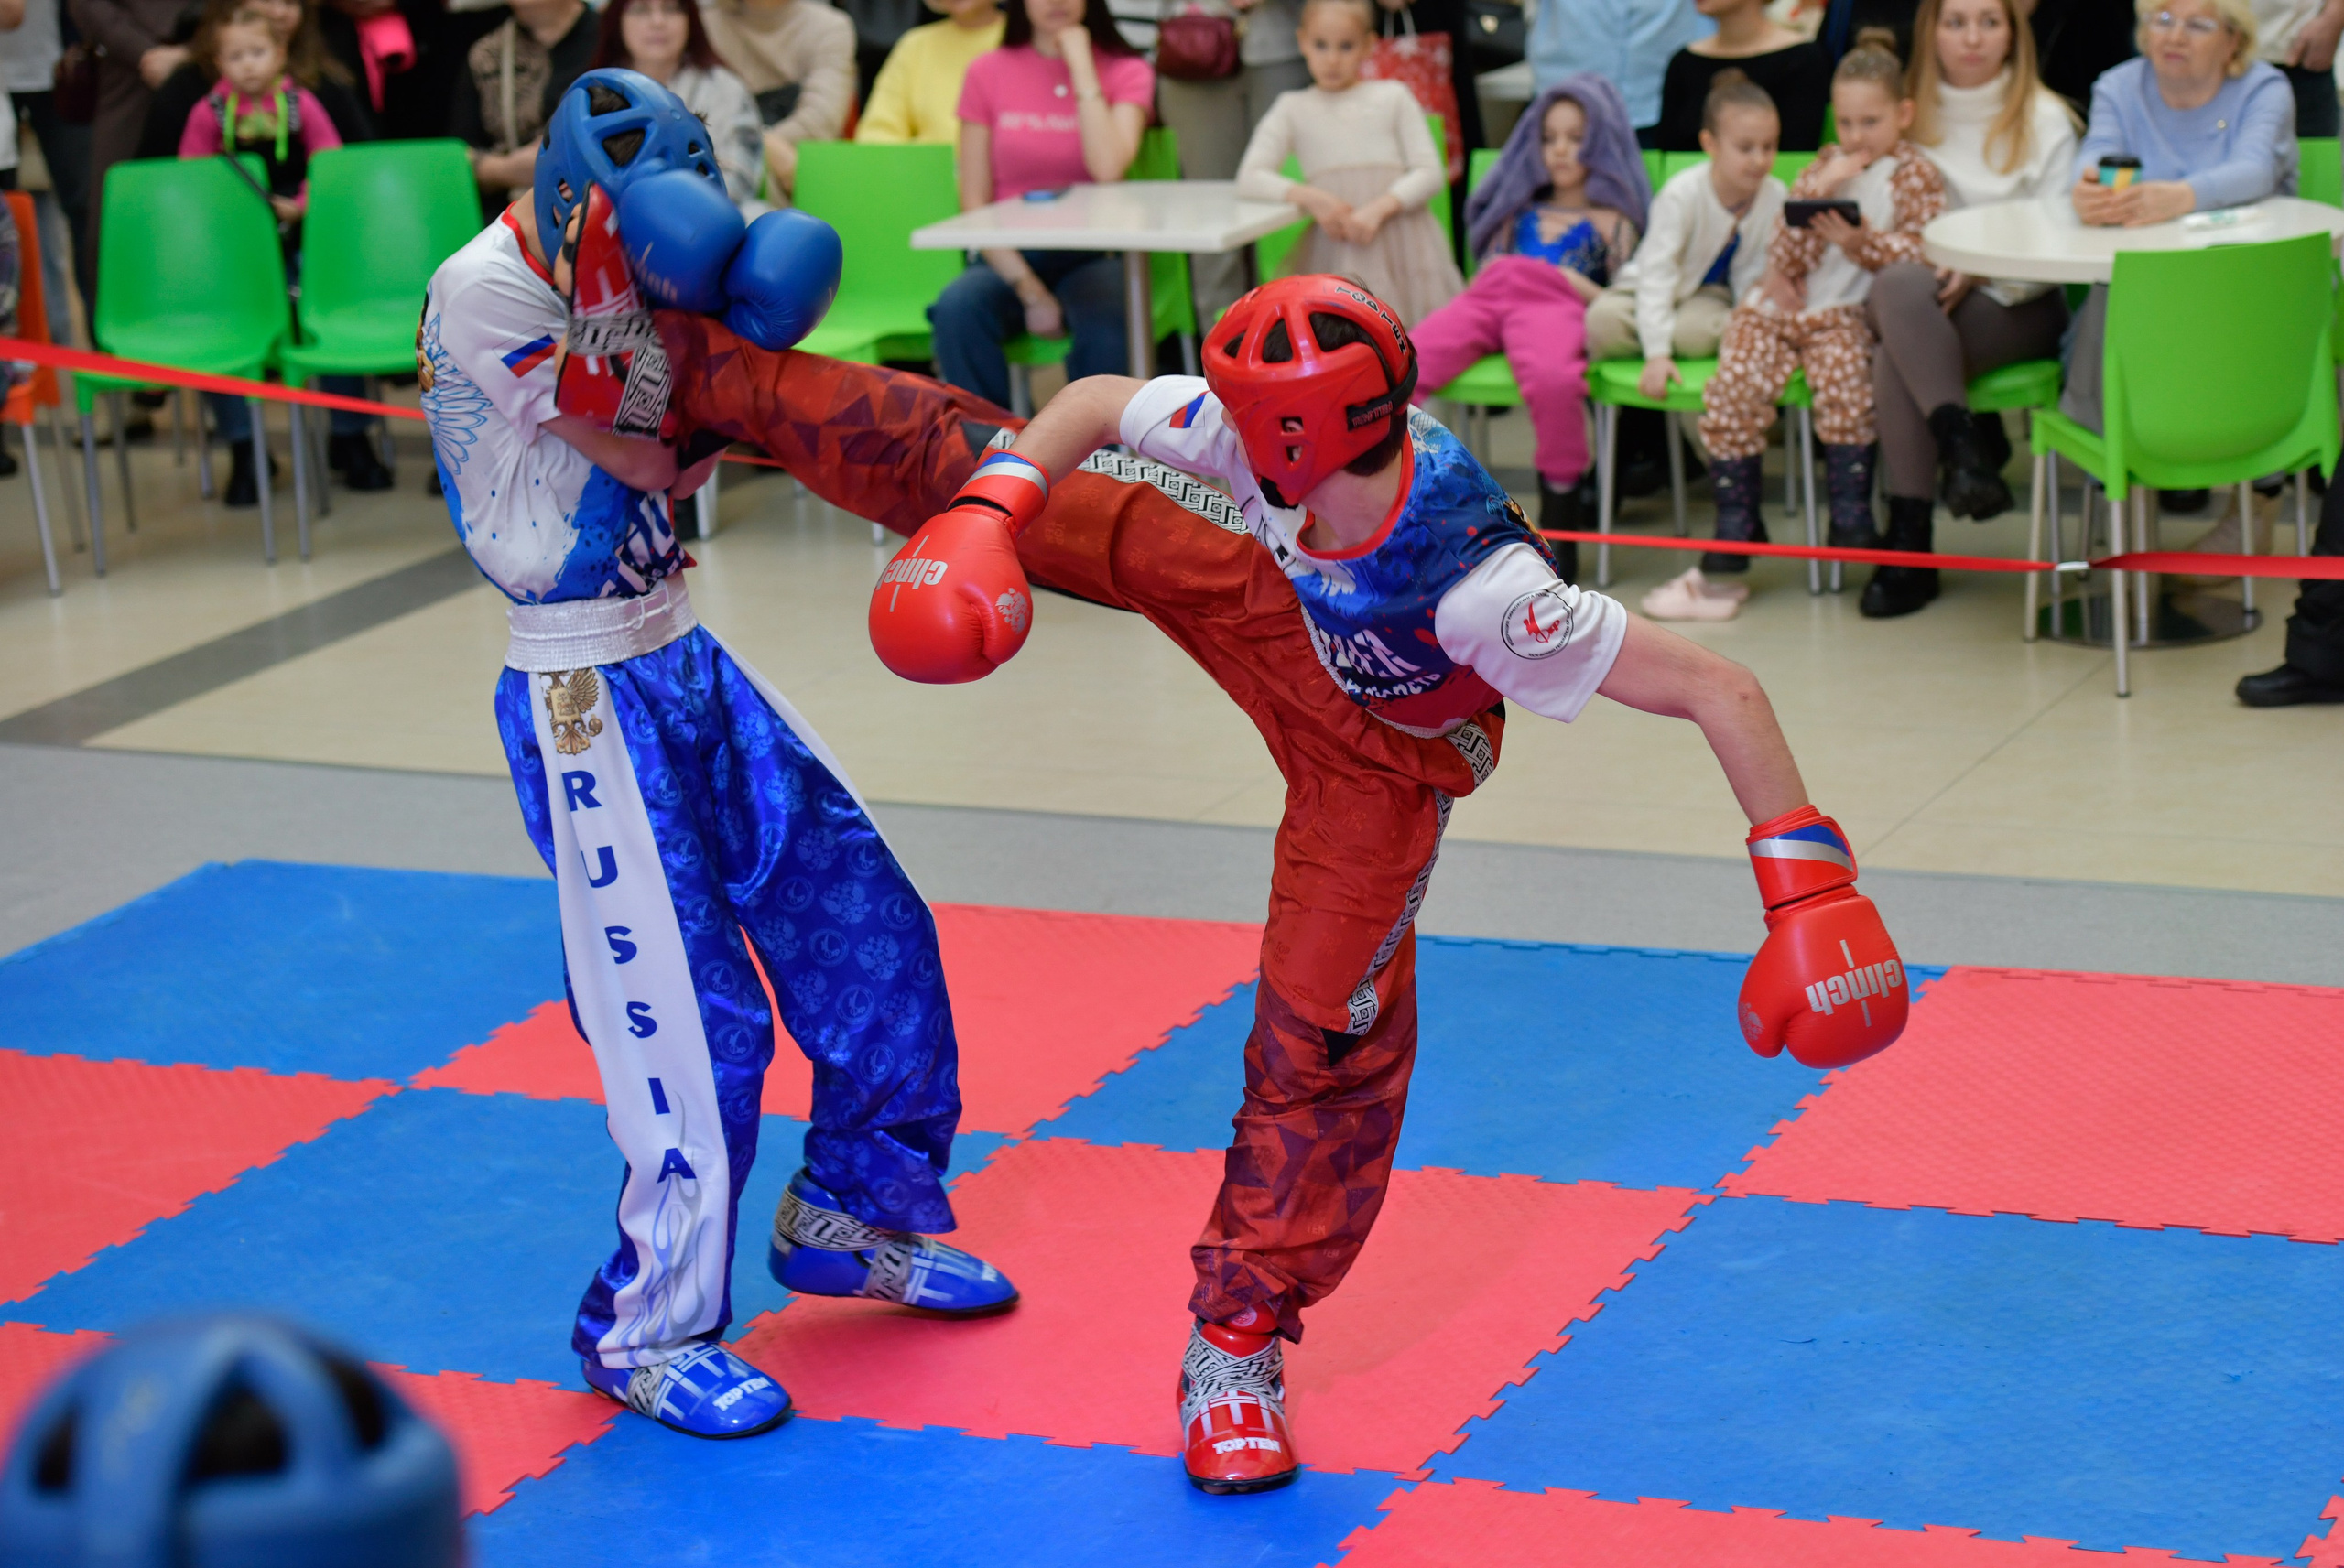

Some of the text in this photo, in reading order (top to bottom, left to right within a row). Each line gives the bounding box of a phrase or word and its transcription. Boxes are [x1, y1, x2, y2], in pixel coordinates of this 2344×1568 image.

[1335, 287, 1406, 356] TOP TEN
[562, 770, 698, 1184] RUSSIA
[1805, 959, 1903, 1016] clinch
[712, 1377, 773, 1411] TOP TEN
[1212, 1437, 1281, 1454] TOP TEN
